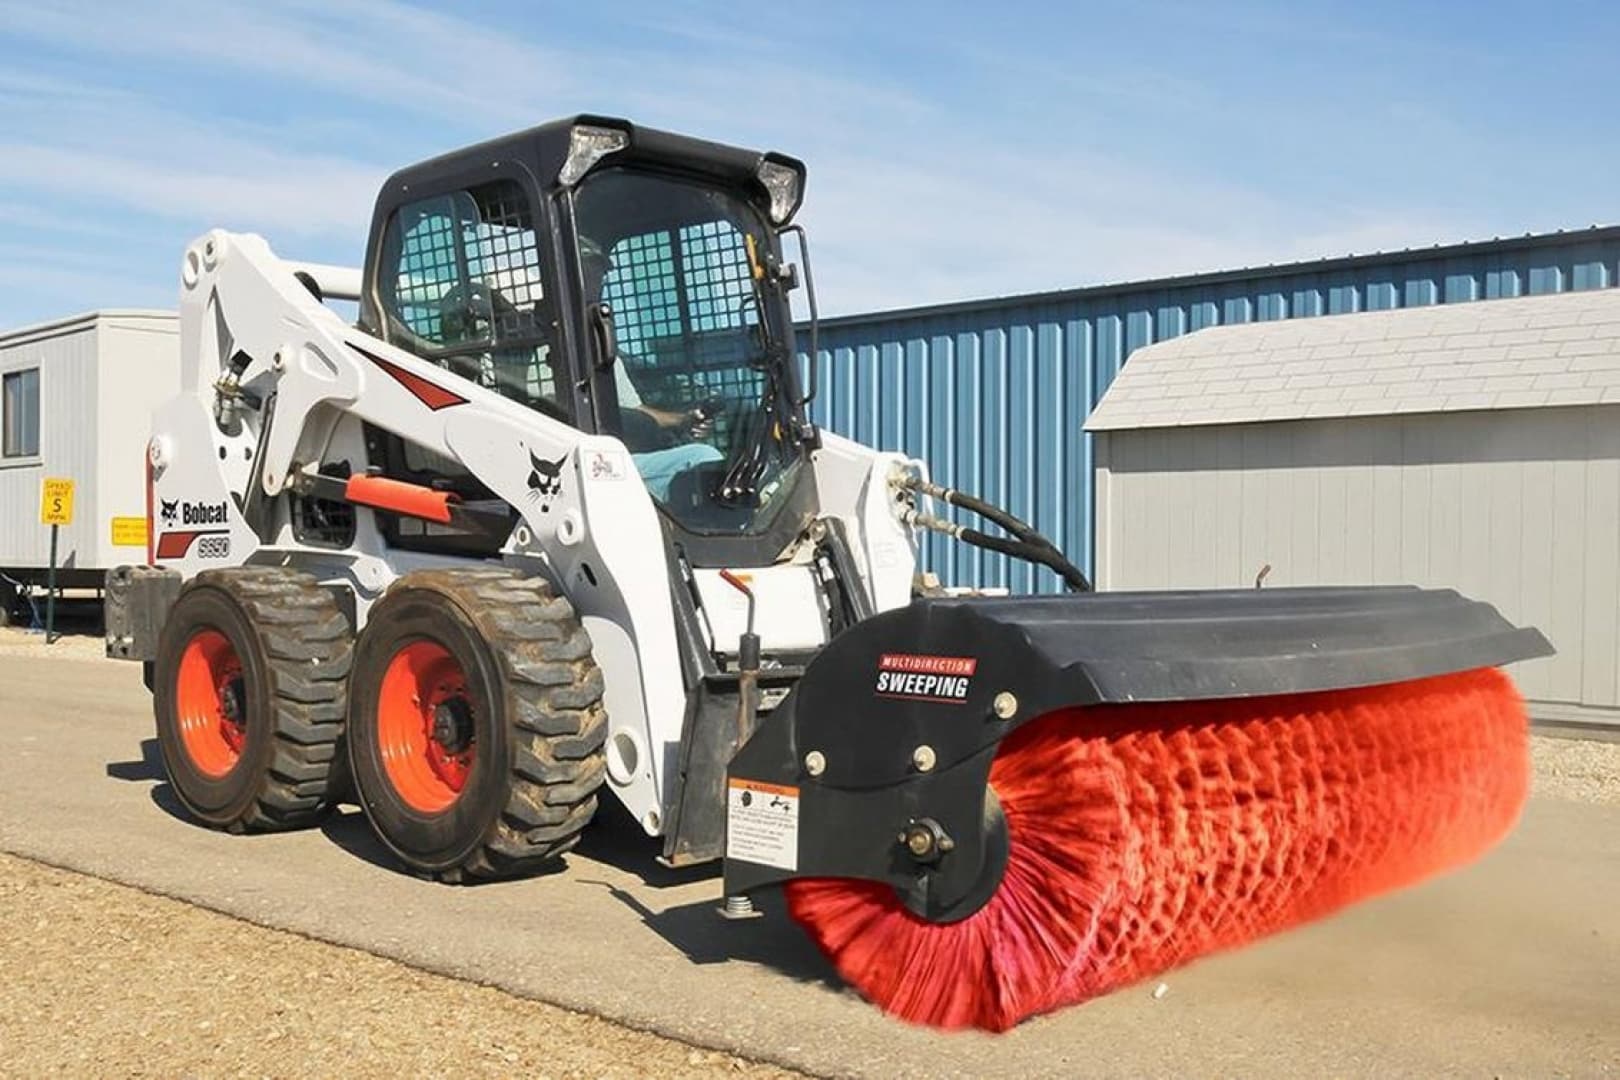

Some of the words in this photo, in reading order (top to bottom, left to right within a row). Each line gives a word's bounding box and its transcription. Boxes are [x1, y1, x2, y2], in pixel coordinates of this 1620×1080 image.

[183, 501, 227, 524] Bobcat
[882, 657, 972, 672] MULTIDIRECTION
[877, 671, 969, 698] SWEEPING
